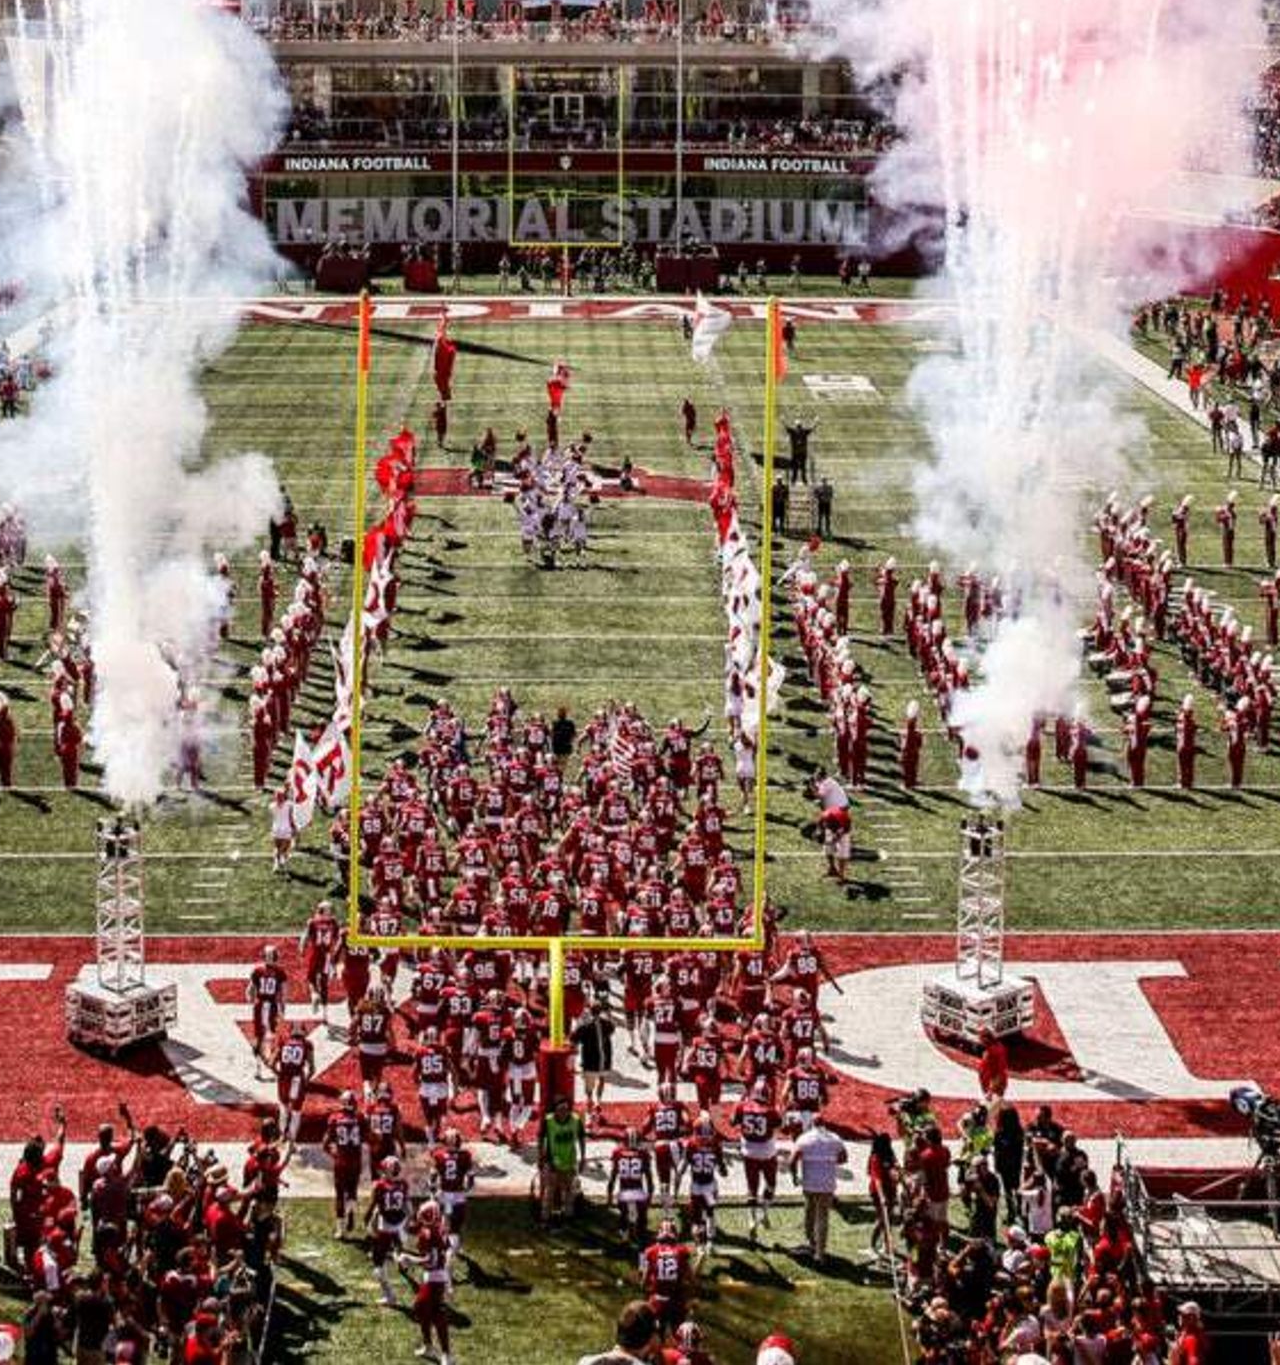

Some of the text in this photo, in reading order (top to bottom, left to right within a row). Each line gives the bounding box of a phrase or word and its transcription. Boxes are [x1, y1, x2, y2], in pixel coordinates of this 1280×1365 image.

[285, 157, 431, 171] INDIANA FOOTBALL
[704, 157, 849, 173] INDIANA FOOTBALL
[276, 195, 867, 244] MEMORIAL STADIUM
[259, 977, 276, 995] 10
[422, 973, 445, 989] 67
[655, 1007, 674, 1024] 27
[793, 1020, 812, 1037] 47
[743, 1115, 766, 1135] 53
[445, 1160, 457, 1180] 2
[692, 1153, 715, 1174] 35
[384, 1191, 404, 1210] 13
[656, 1258, 677, 1280] 12
